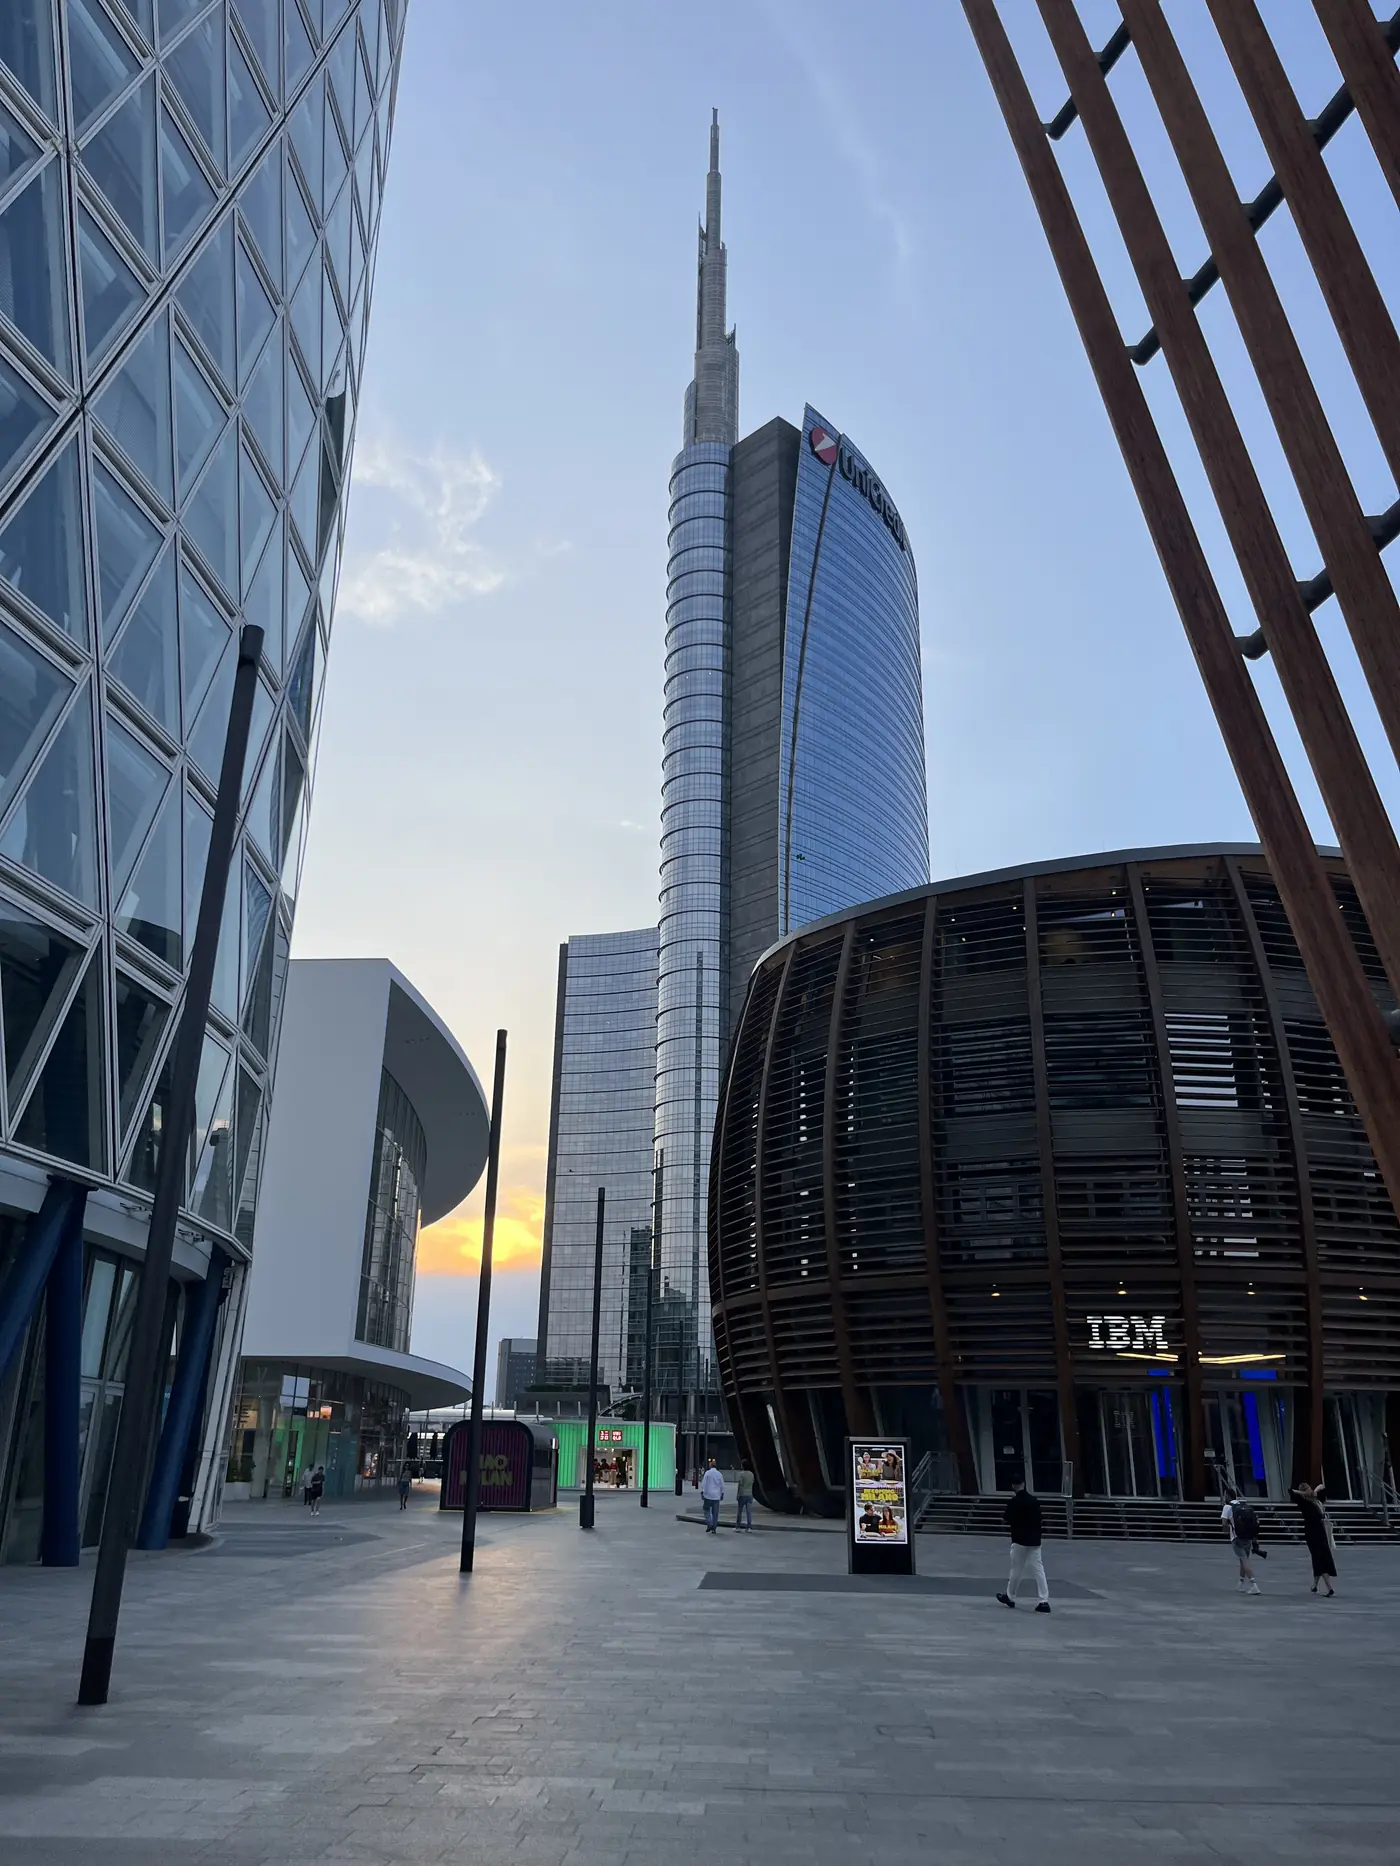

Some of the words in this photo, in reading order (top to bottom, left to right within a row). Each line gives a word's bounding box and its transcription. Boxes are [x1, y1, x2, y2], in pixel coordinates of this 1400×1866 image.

[1087, 1316, 1168, 1349] IBM
[478, 1454, 509, 1470] IAO
[459, 1470, 515, 1486] LAN
